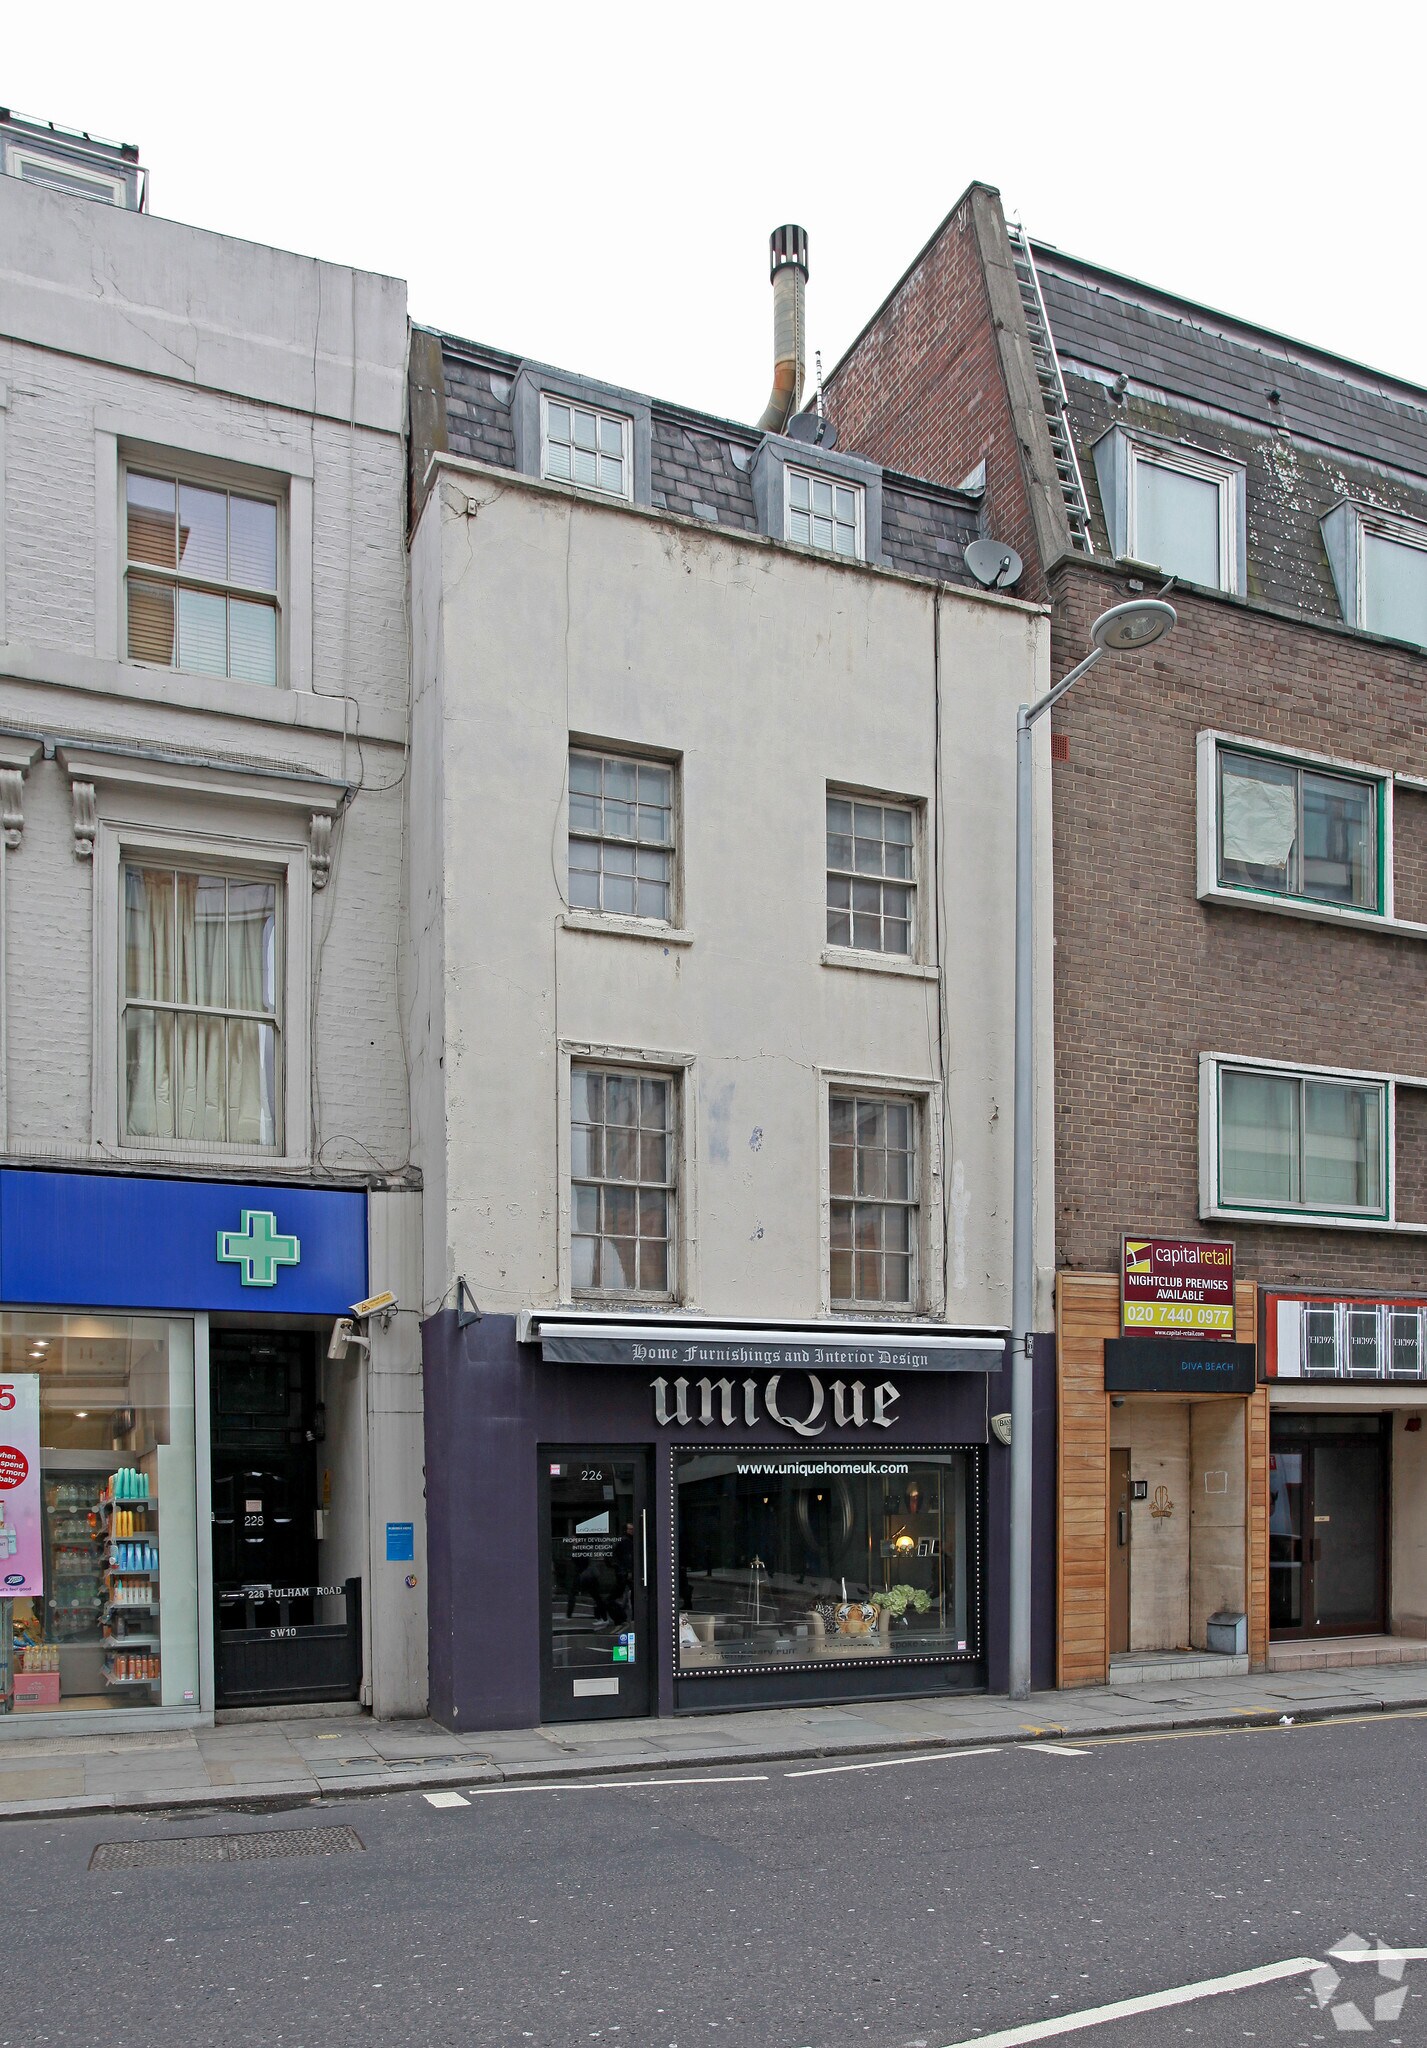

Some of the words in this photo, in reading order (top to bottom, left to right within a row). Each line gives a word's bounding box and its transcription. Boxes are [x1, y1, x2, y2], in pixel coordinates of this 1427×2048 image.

[1128, 1275, 1183, 1288] NIGHTCLUB
[1185, 1278, 1229, 1291] PREMISES
[1156, 1289, 1205, 1301] AVAILABLE
[1127, 1305, 1154, 1321] 020
[1159, 1307, 1193, 1323] 7440
[1197, 1309, 1229, 1325] 0977
[1154, 1329, 1205, 1337] www.capital-retail.com
[631, 1343, 678, 1362] Home
[682, 1345, 781, 1364] Furnishings
[784, 1350, 810, 1362] and
[814, 1348, 875, 1364] Interior
[877, 1350, 929, 1368] Design
[1181, 1361, 1203, 1371] DIVA
[1205, 1362, 1234, 1371] BEACH
[0, 1460, 24, 1469] spend
[736, 1461, 909, 1476] www.uniquehomeuk.com
[6, 1469, 26, 1478] more
[581, 1470, 603, 1481] 226
[244, 1515, 264, 1527] 228
[248, 1590, 265, 1599] 228
[267, 1587, 310, 1598] FULHAM
[316, 1586, 342, 1596] ROAD
[270, 1628, 297, 1638] SW10
